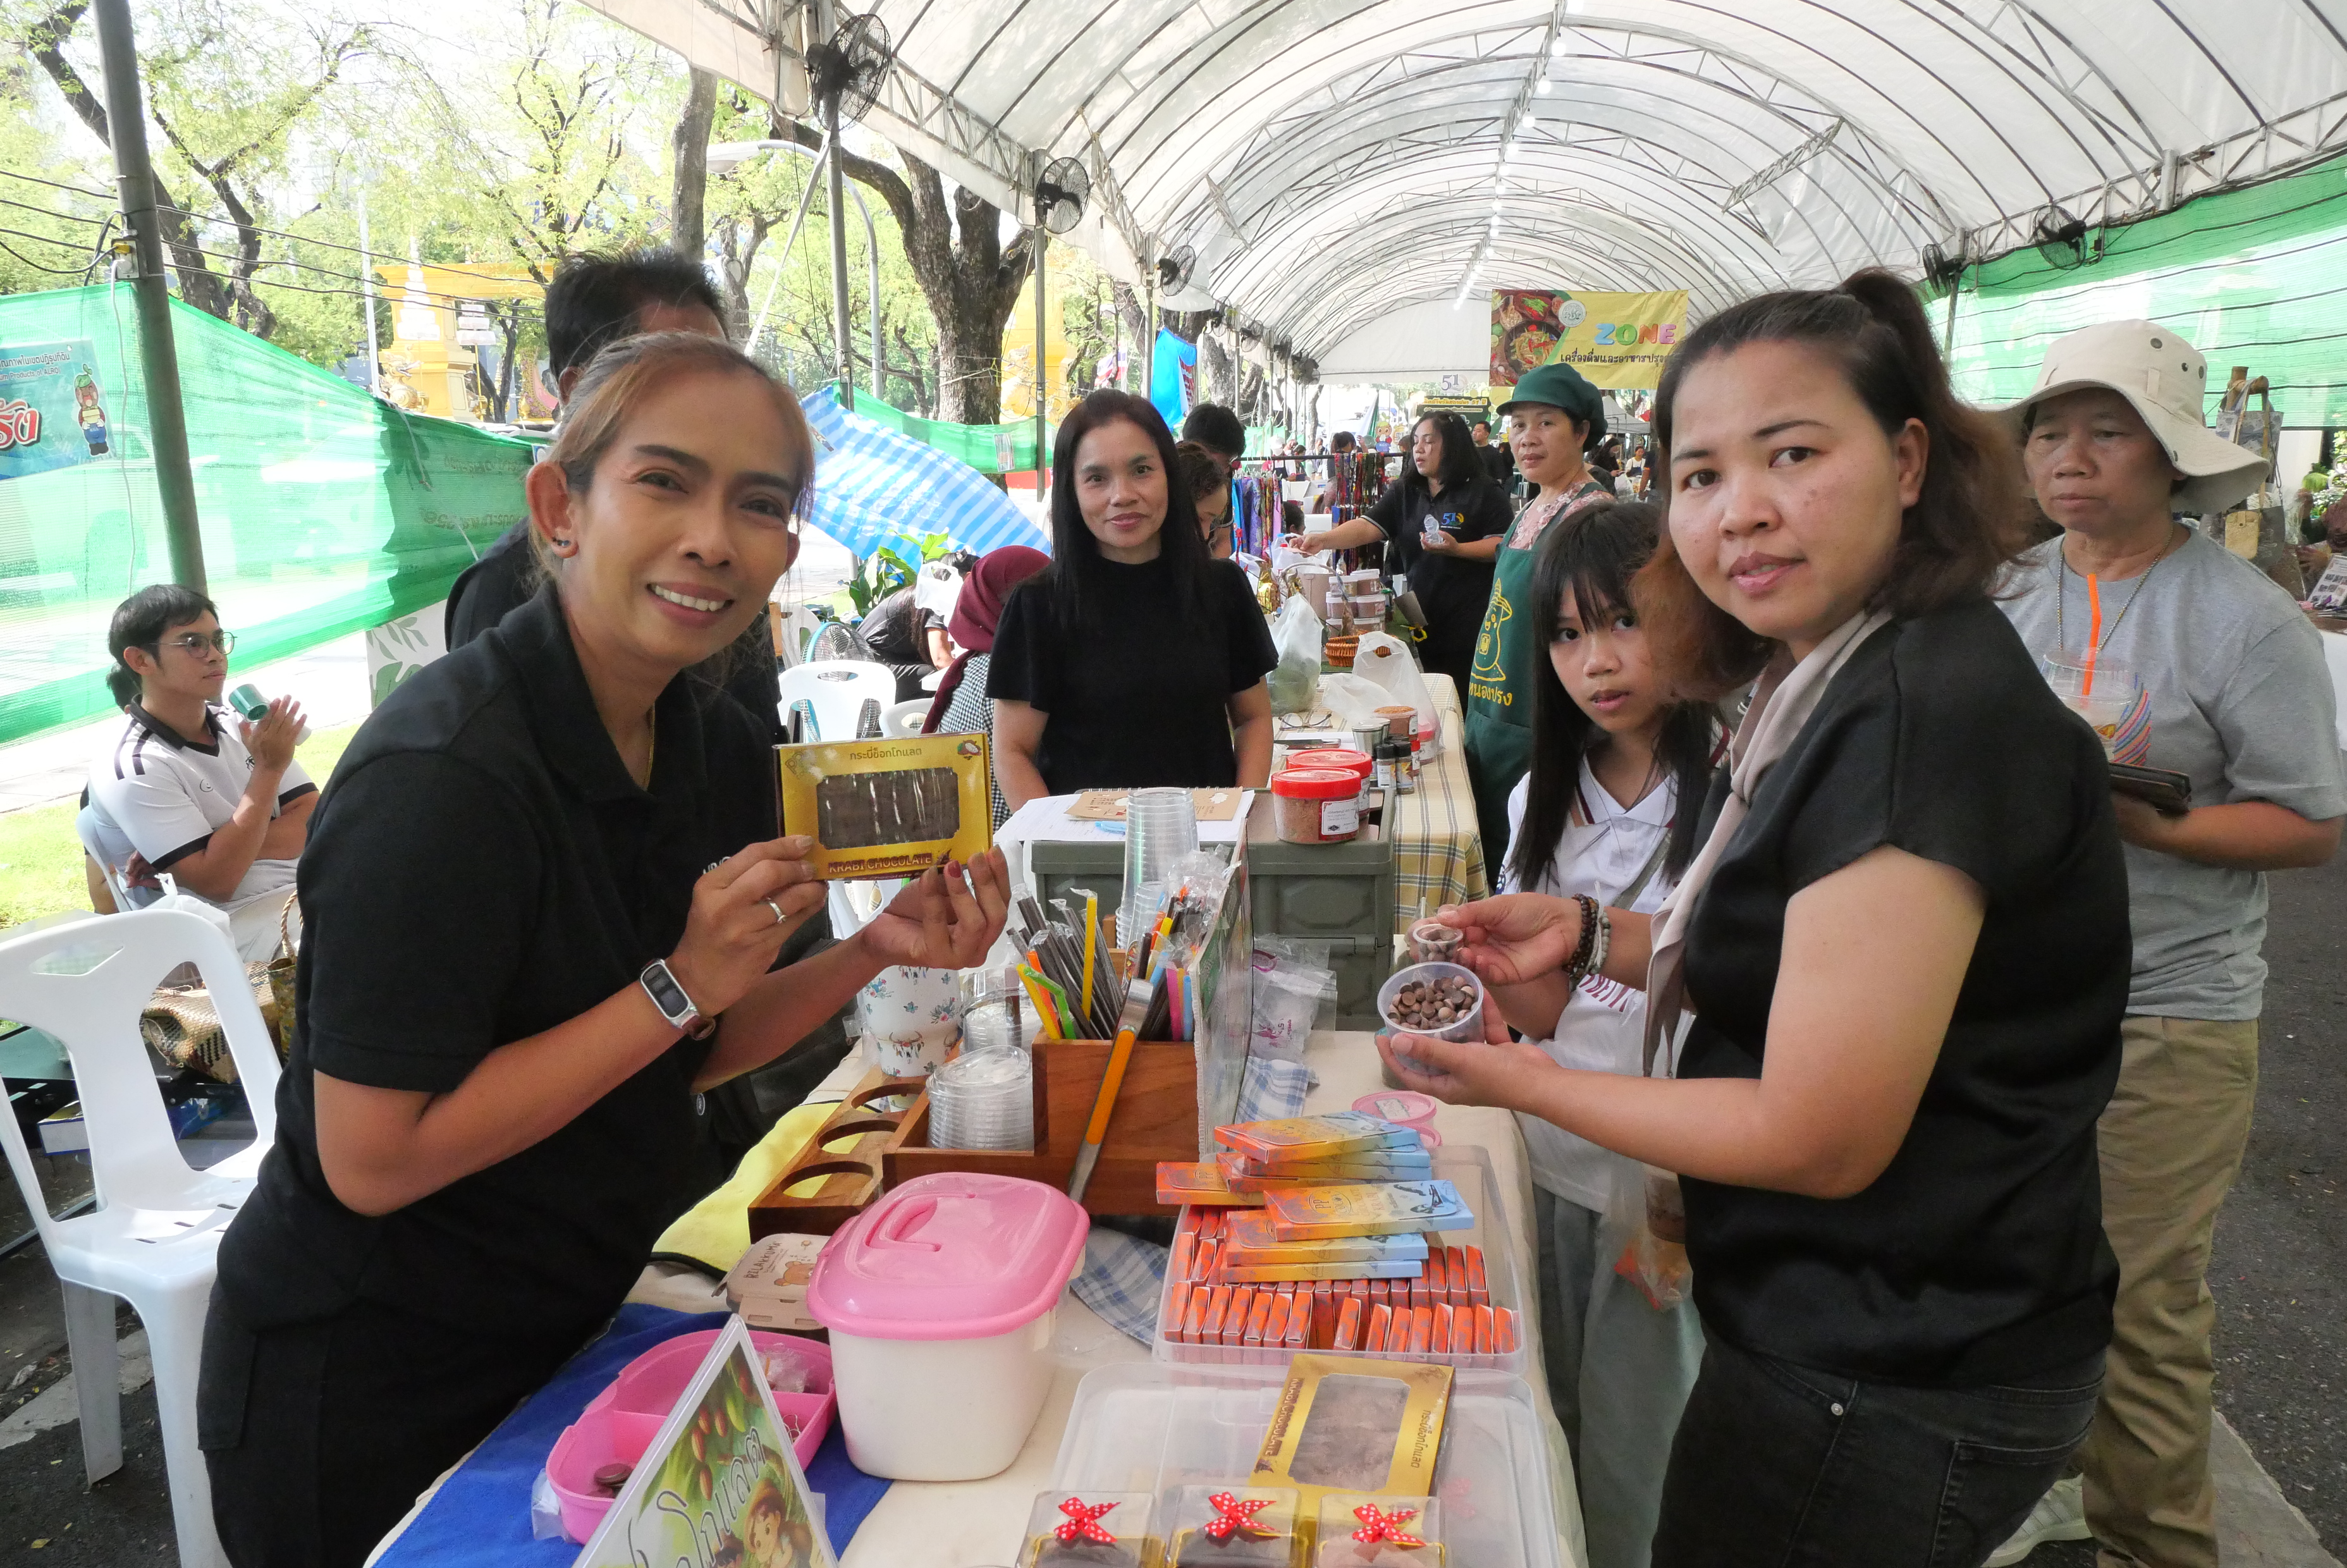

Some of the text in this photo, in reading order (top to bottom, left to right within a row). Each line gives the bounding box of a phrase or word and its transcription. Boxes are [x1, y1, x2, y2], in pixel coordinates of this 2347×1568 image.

[1594, 323, 1677, 345] ZONE
[10, 371, 35, 379] Products
[1442, 374, 1459, 391] 51
[1442, 512, 1456, 525] 51
[829, 854, 932, 873] KRABI CHOCOLATE
[745, 1240, 783, 1278] RILAKKUMA
